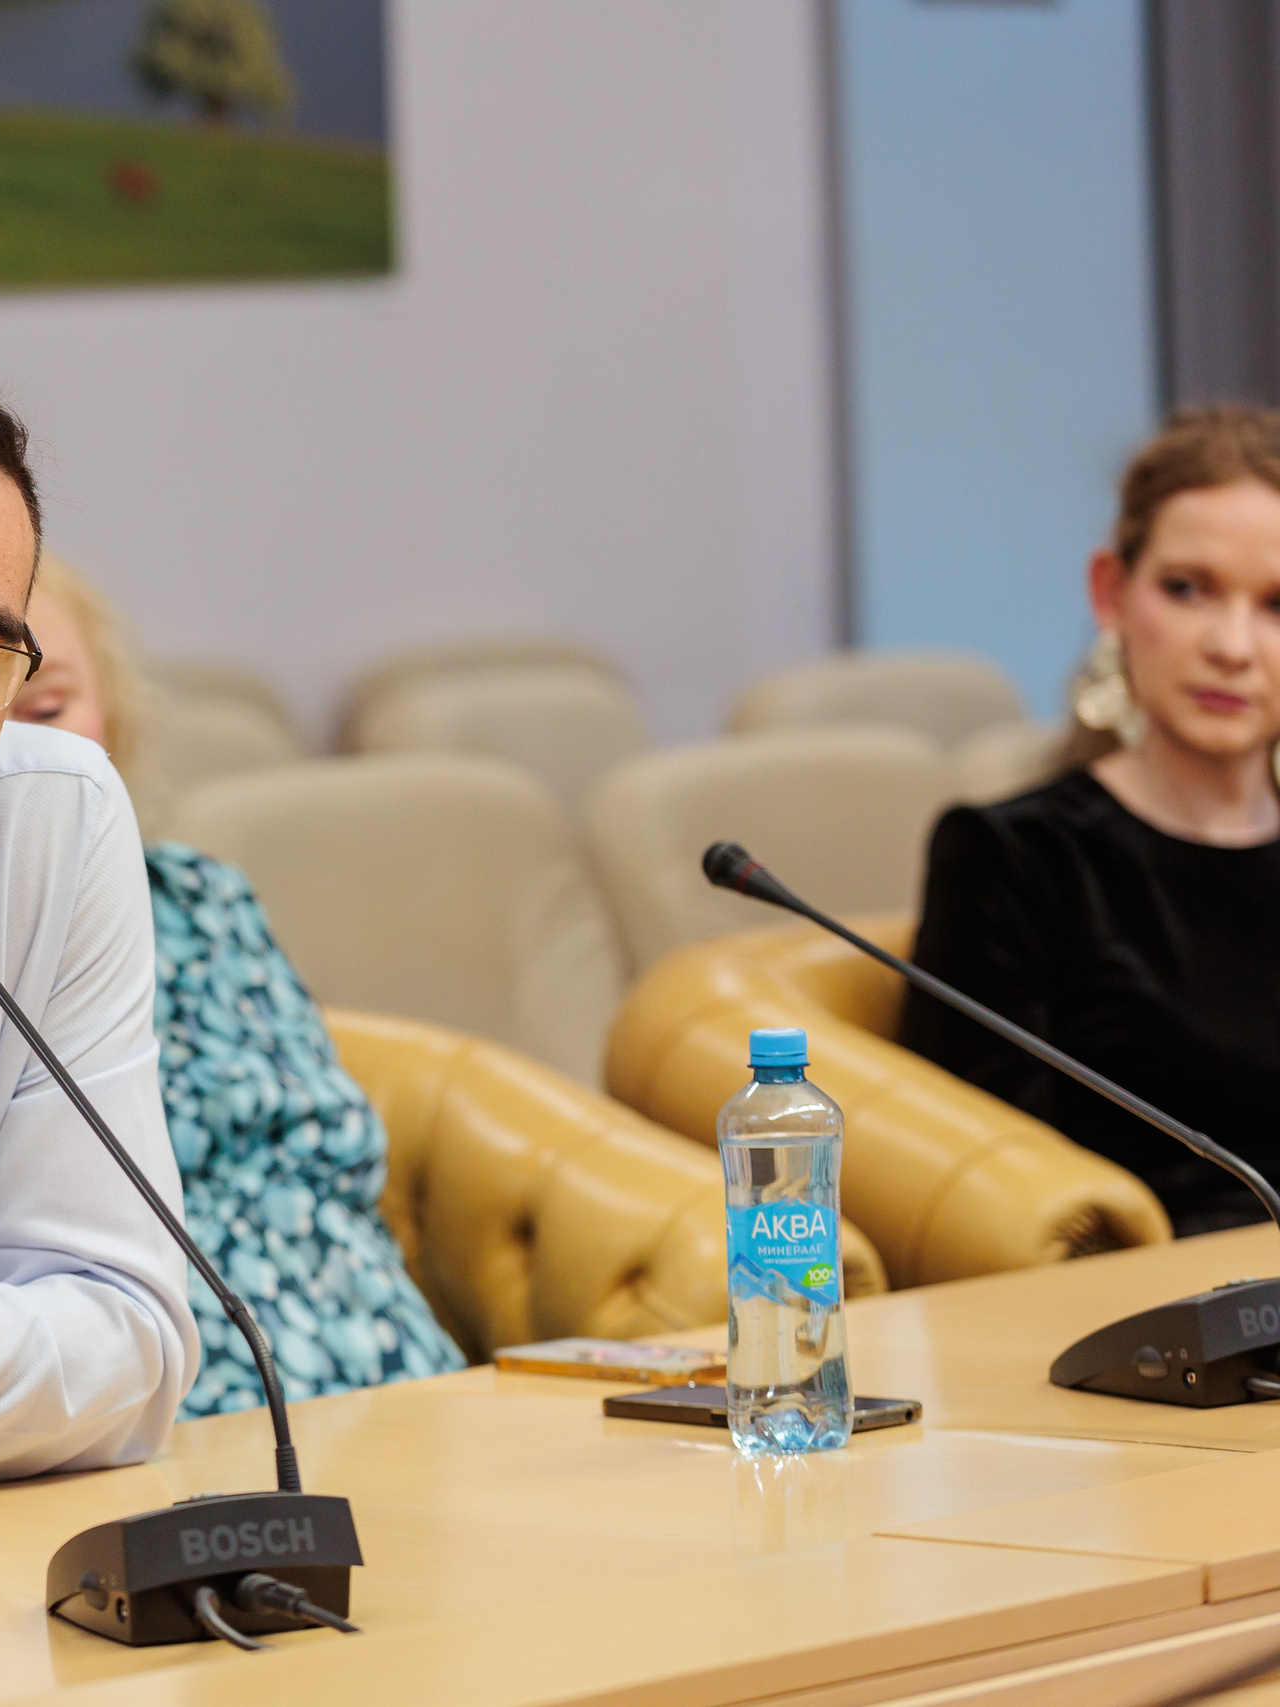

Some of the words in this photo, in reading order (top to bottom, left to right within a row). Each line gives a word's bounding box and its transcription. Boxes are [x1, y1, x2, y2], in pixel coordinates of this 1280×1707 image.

[751, 1210, 827, 1243] АКВА
[758, 1244, 823, 1256] МИНЕРАЛЕ
[1239, 1304, 1280, 1337] BO
[179, 1517, 316, 1565] BOSCH
